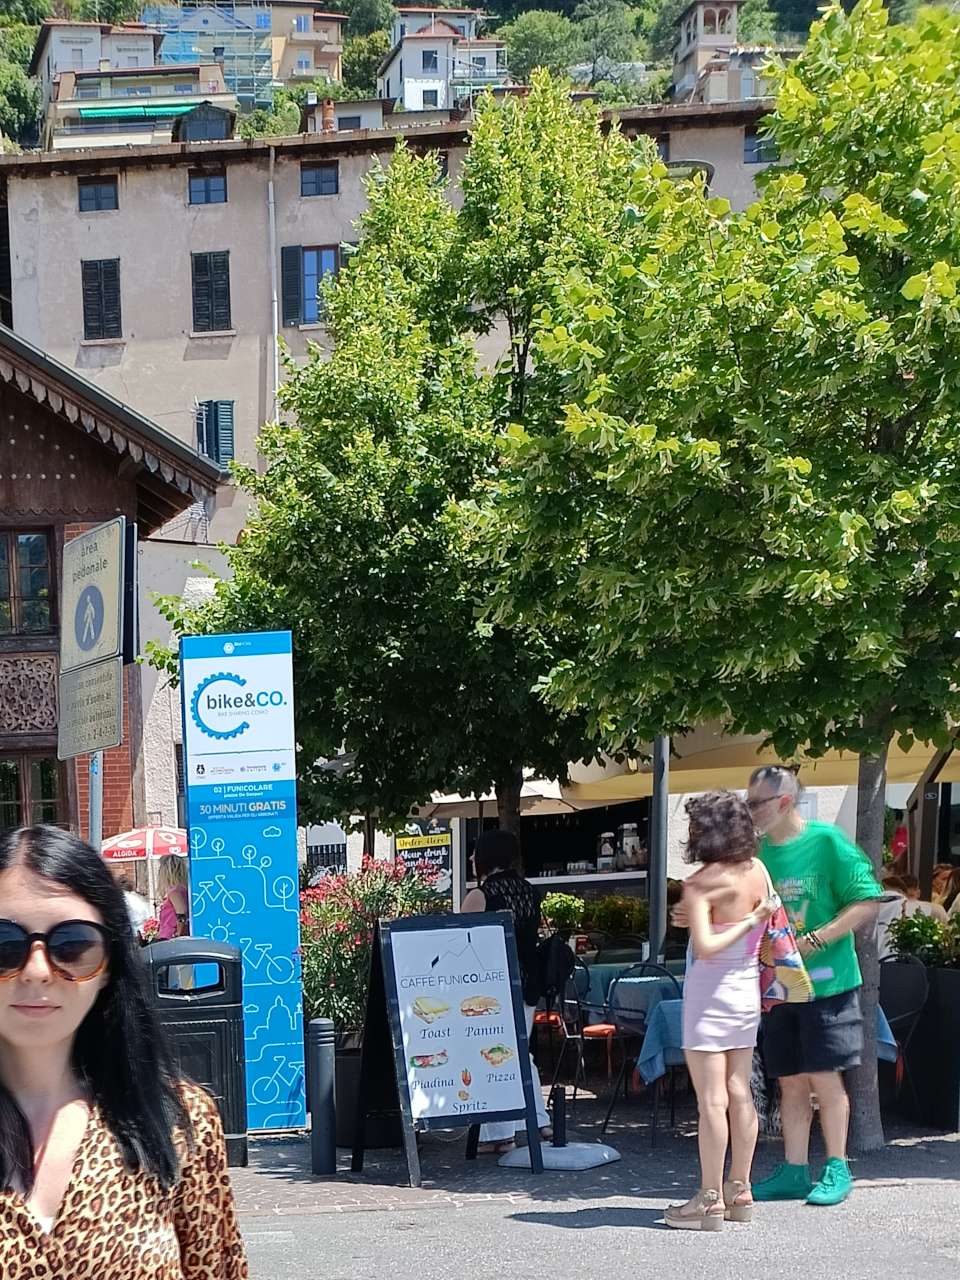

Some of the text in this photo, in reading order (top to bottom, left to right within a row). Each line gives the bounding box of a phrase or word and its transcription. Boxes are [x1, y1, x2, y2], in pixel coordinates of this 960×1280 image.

[81, 542, 98, 557] area
[72, 558, 108, 584] pedonale
[207, 691, 287, 710] bike&CO.
[227, 784, 273, 793] FUNICOLARE
[200, 800, 286, 815] 30 MINUTI GRATIS
[400, 847, 448, 859] Your drink
[438, 971, 505, 986] FUNICOLARE
[420, 1024, 505, 1040] Toast Panini
[412, 1072, 516, 1090] Piadina Pizza
[452, 1101, 488, 1113] Spritz
